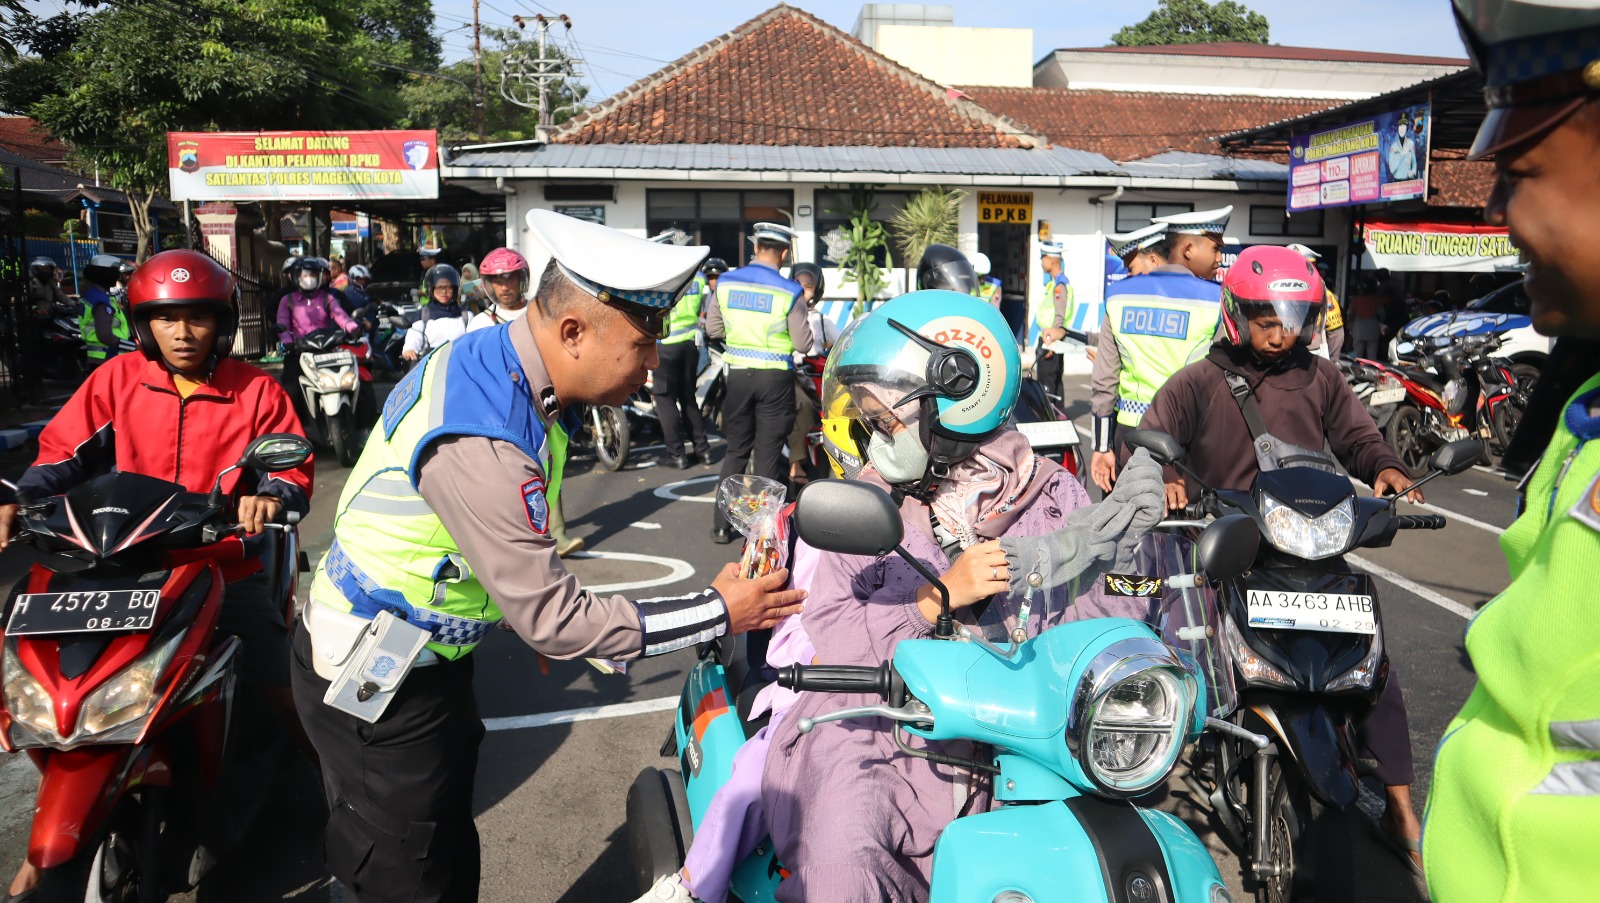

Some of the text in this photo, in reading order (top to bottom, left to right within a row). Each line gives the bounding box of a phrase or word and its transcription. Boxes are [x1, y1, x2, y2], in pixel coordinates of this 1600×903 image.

[255, 136, 350, 151] SELAMAT DATANG
[1306, 134, 1378, 160] POLRES MAGELANG KOTA
[225, 153, 380, 169] DI KANTOR PELAYANAN BPKB
[205, 170, 403, 187] SATLANTAS POLRES MAGELANG KOTA
[1329, 165, 1341, 177] 110
[980, 193, 1030, 205] PELAYANAN
[983, 208, 1027, 221] BPKB
[1371, 232, 1423, 256] "RUANG
[1424, 233, 1478, 257] TUNGGU
[729, 291, 770, 311] POLISI
[1123, 310, 1186, 335] POLISI
[931, 328, 992, 359] azzio
[1294, 497, 1327, 505] HONDA
[92, 506, 130, 515] HONDA
[14, 591, 157, 615] H 4573 BQ
[1249, 592, 1373, 613] AA 3463 AHB
